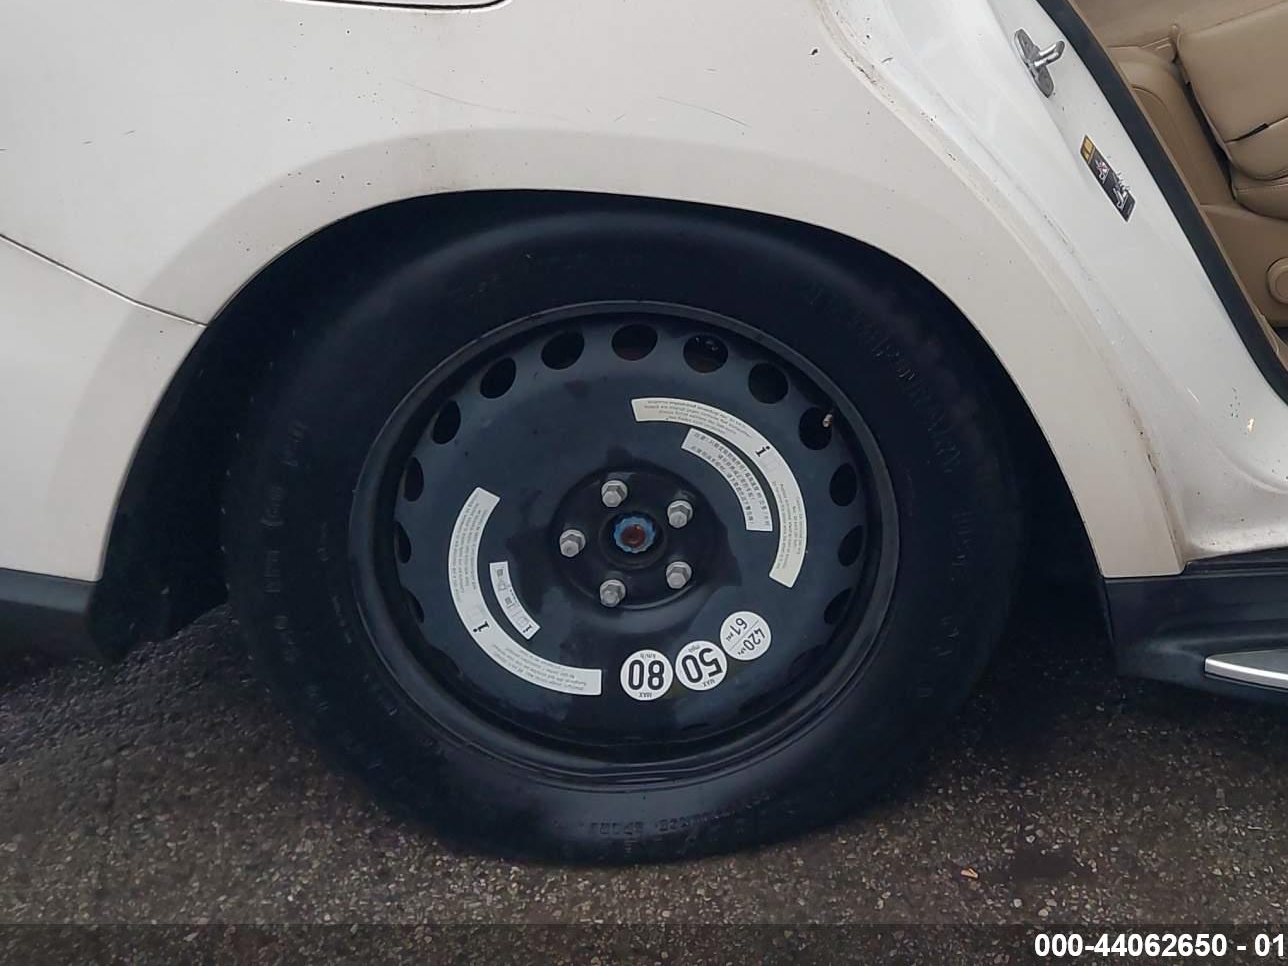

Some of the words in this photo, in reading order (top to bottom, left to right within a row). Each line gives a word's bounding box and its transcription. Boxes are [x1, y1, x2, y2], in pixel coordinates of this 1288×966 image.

[730, 617, 748, 635] 61
[742, 628, 765, 651] 420
[628, 659, 665, 690] 80
[681, 647, 724, 683] 50
[703, 679, 716, 687] MAX
